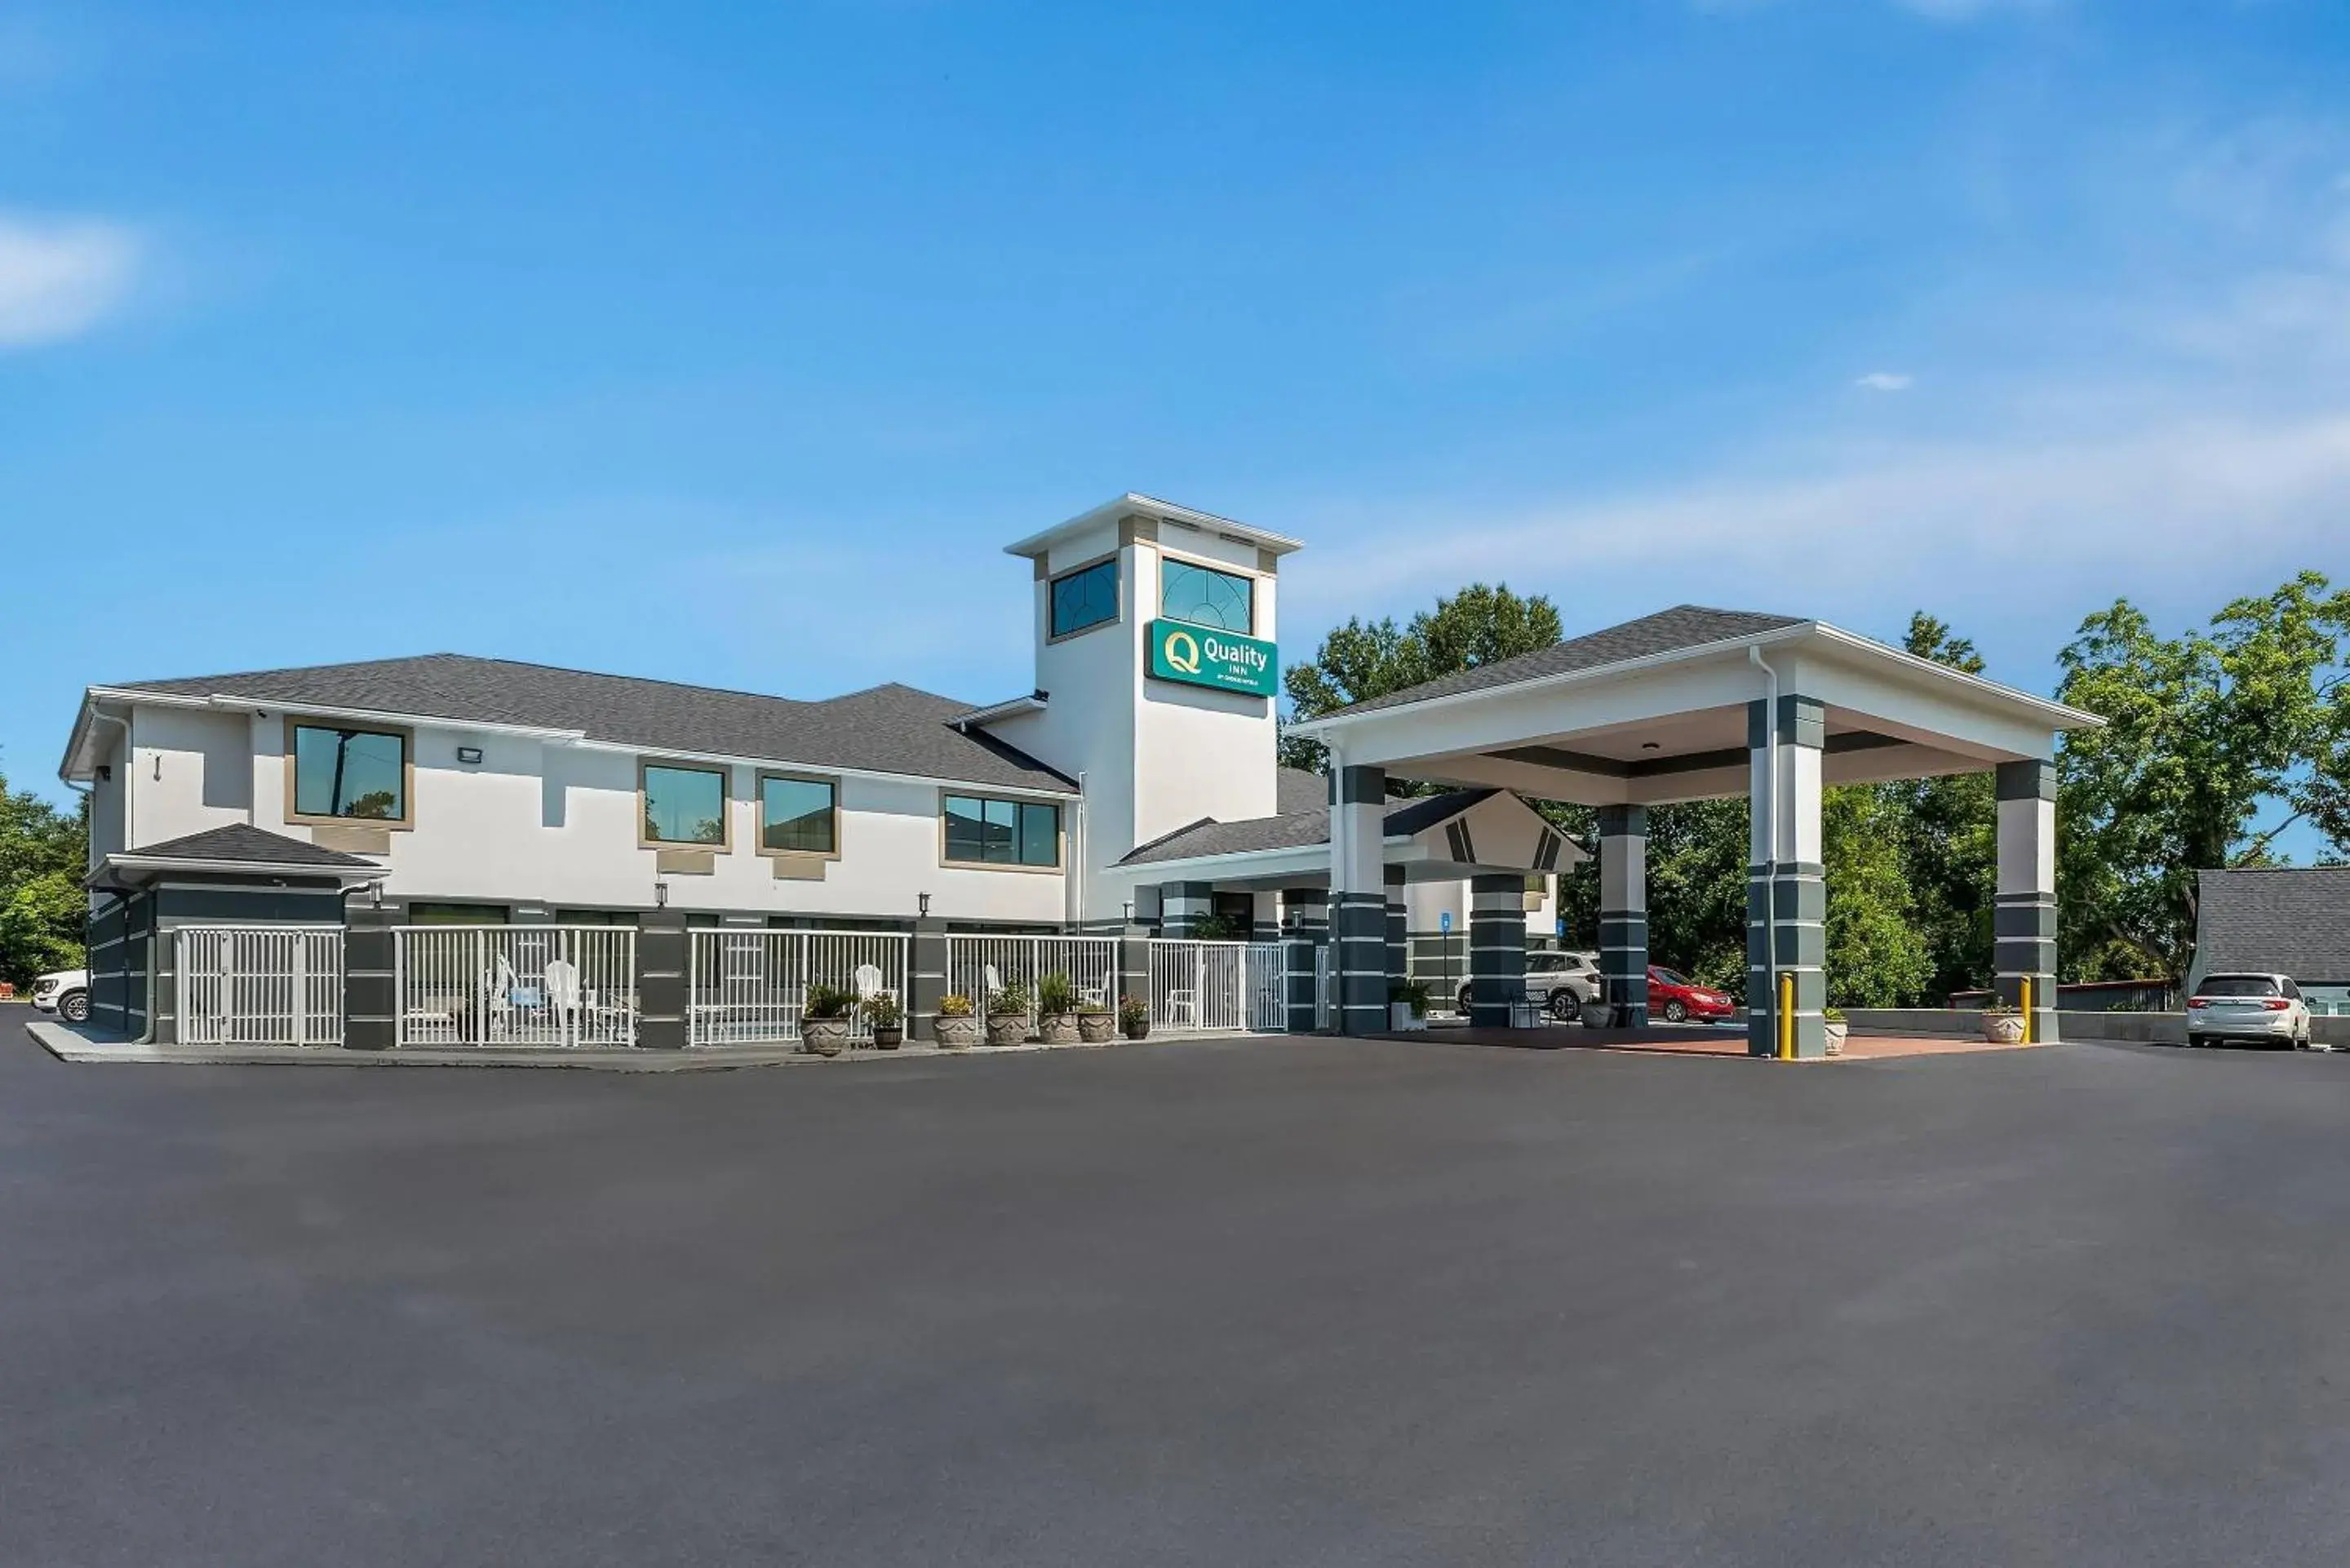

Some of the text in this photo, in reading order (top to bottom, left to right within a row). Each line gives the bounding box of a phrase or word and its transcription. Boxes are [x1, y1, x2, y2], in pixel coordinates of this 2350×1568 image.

[1165, 631, 1202, 674] Q
[1204, 637, 1267, 671] Quality
[1229, 664, 1248, 676] INN
